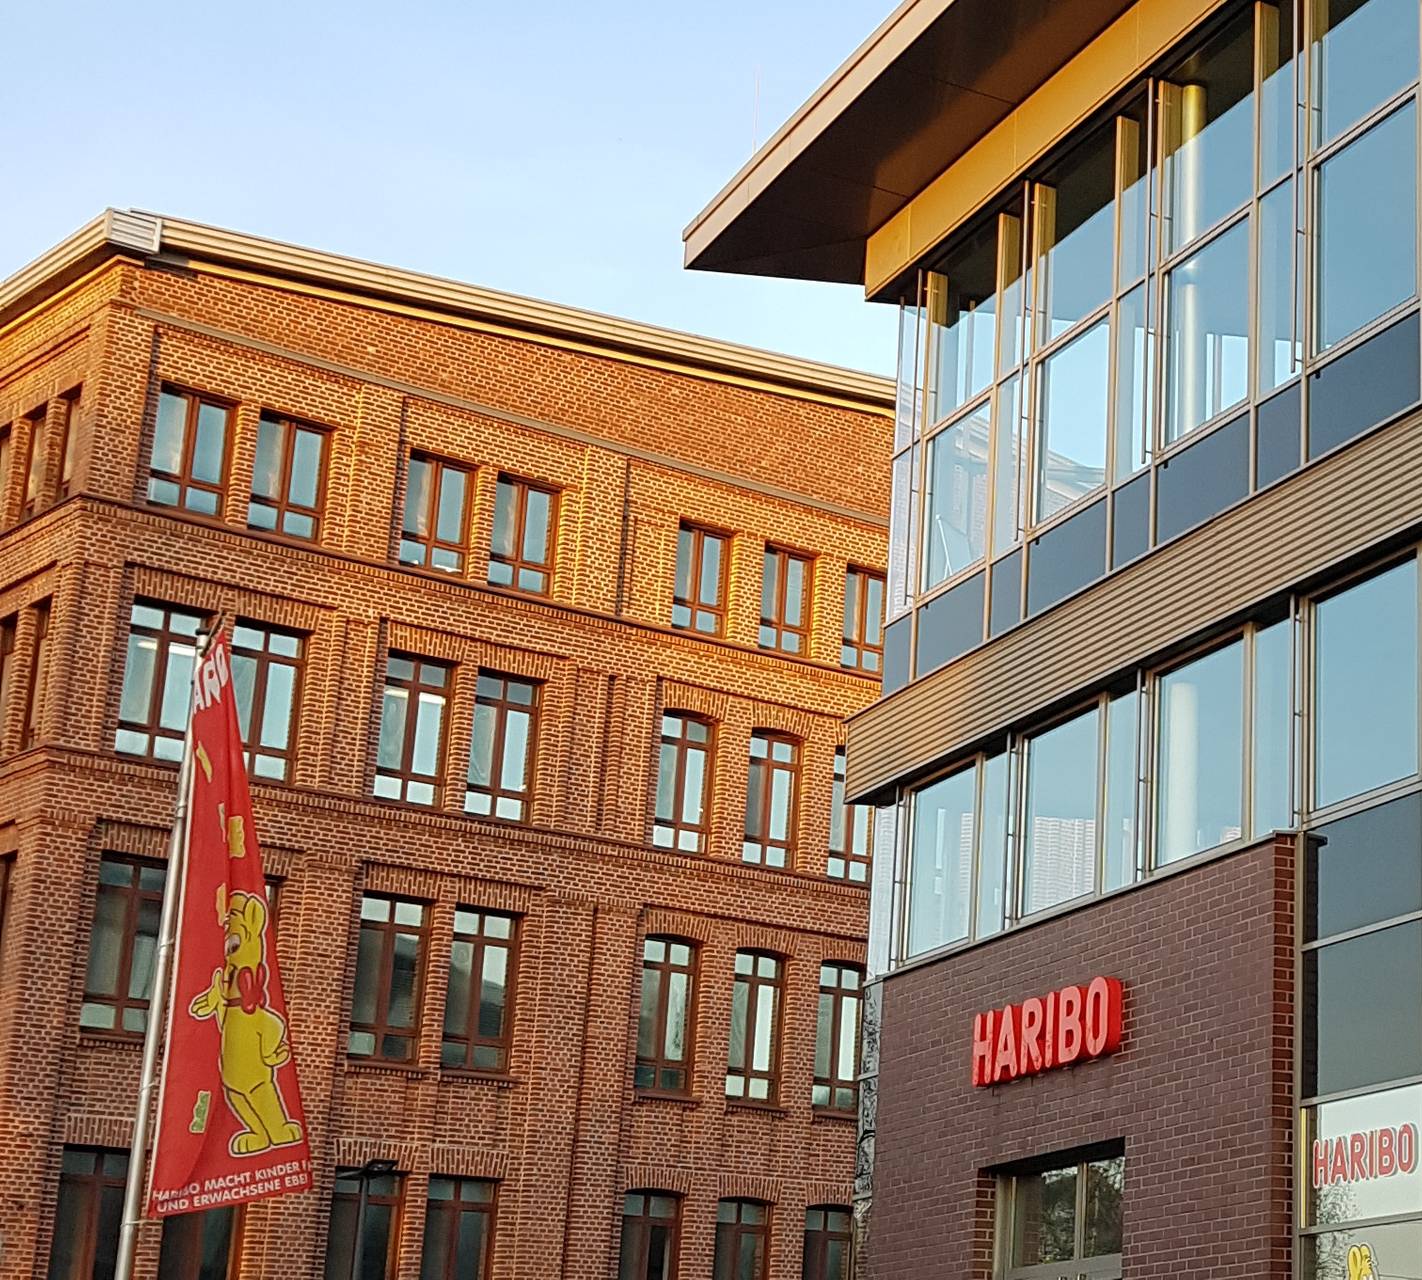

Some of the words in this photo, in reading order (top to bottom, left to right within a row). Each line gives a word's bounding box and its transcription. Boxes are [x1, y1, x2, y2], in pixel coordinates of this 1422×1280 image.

[972, 976, 1121, 1087] HARIBO
[204, 1172, 251, 1191] MACHT
[255, 1161, 300, 1181] KINDER
[1313, 1122, 1417, 1188] HARIBO
[156, 1200, 189, 1213] UND
[193, 1179, 281, 1207] ERWACHSENE
